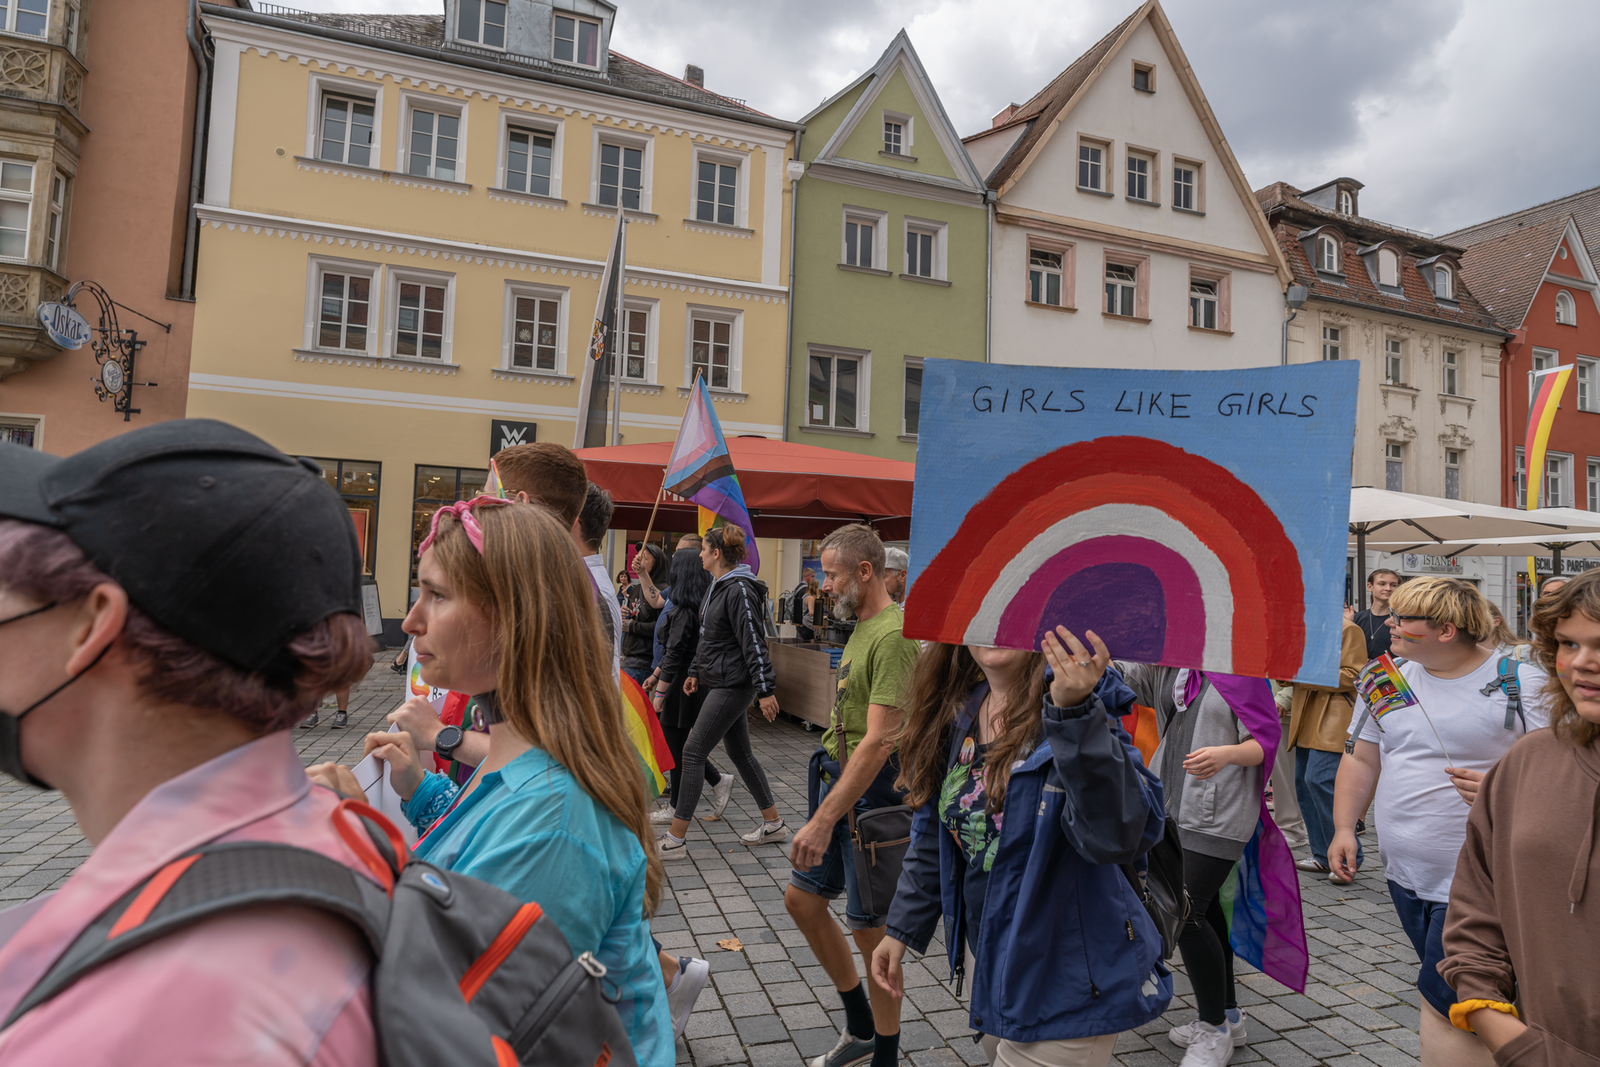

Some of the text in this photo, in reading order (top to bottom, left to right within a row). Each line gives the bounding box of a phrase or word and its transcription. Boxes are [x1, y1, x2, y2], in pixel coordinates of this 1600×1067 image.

[53, 305, 82, 340] Oskar
[973, 386, 1318, 418] GIRLS LIKE GIRLS
[1537, 558, 1565, 571] SCHLS
